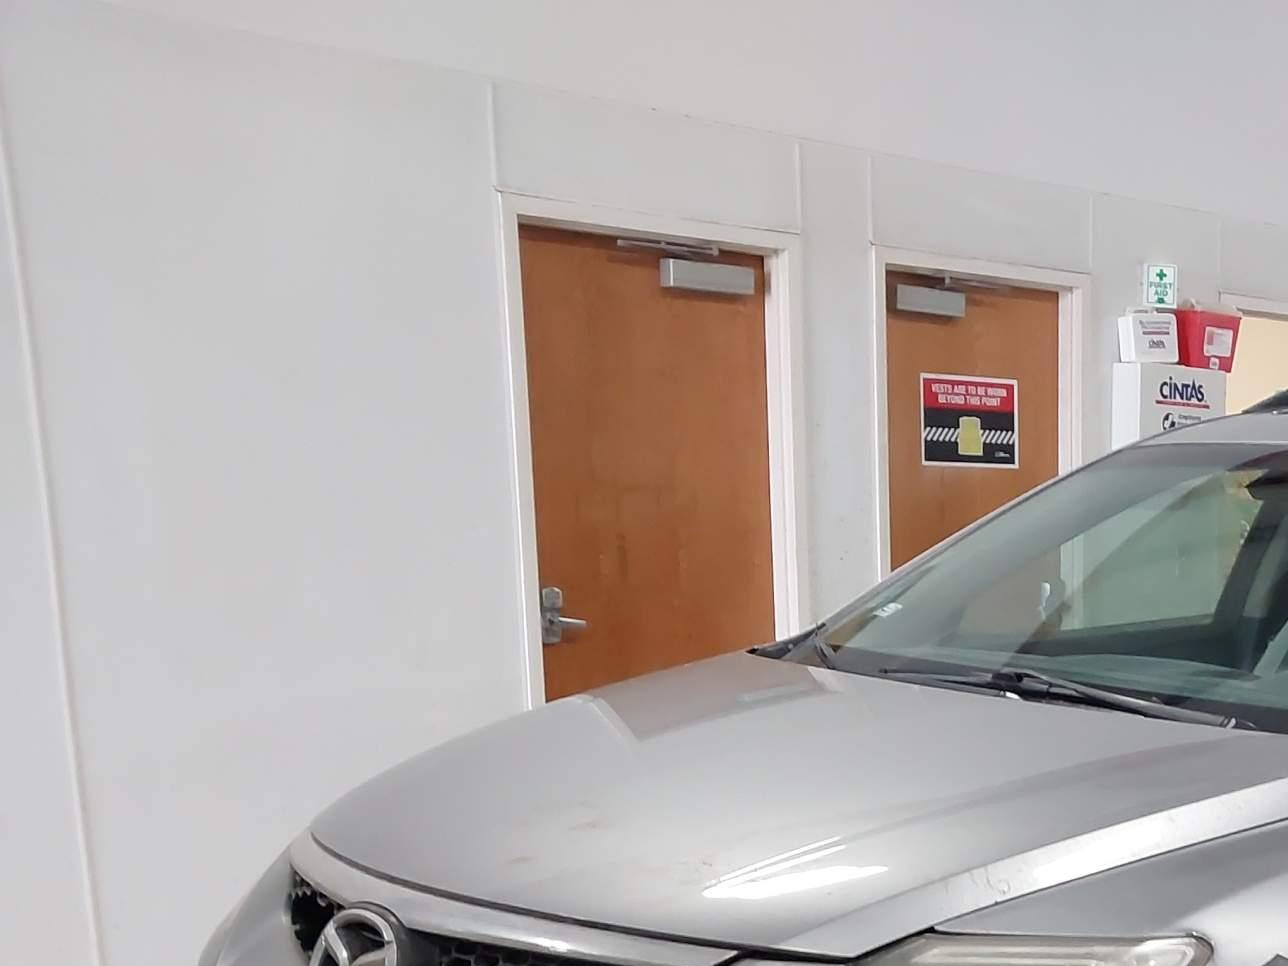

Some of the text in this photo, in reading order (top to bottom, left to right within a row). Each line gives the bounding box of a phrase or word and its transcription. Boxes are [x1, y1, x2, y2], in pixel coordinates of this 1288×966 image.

[1149, 281, 1172, 289] FIRST
[1154, 289, 1169, 297] AID
[931, 383, 952, 394] VESTS
[953, 384, 967, 395] ARE
[968, 385, 976, 395] TO
[977, 386, 985, 396] BE
[938, 393, 1001, 407] BEYOND THIS POINT
